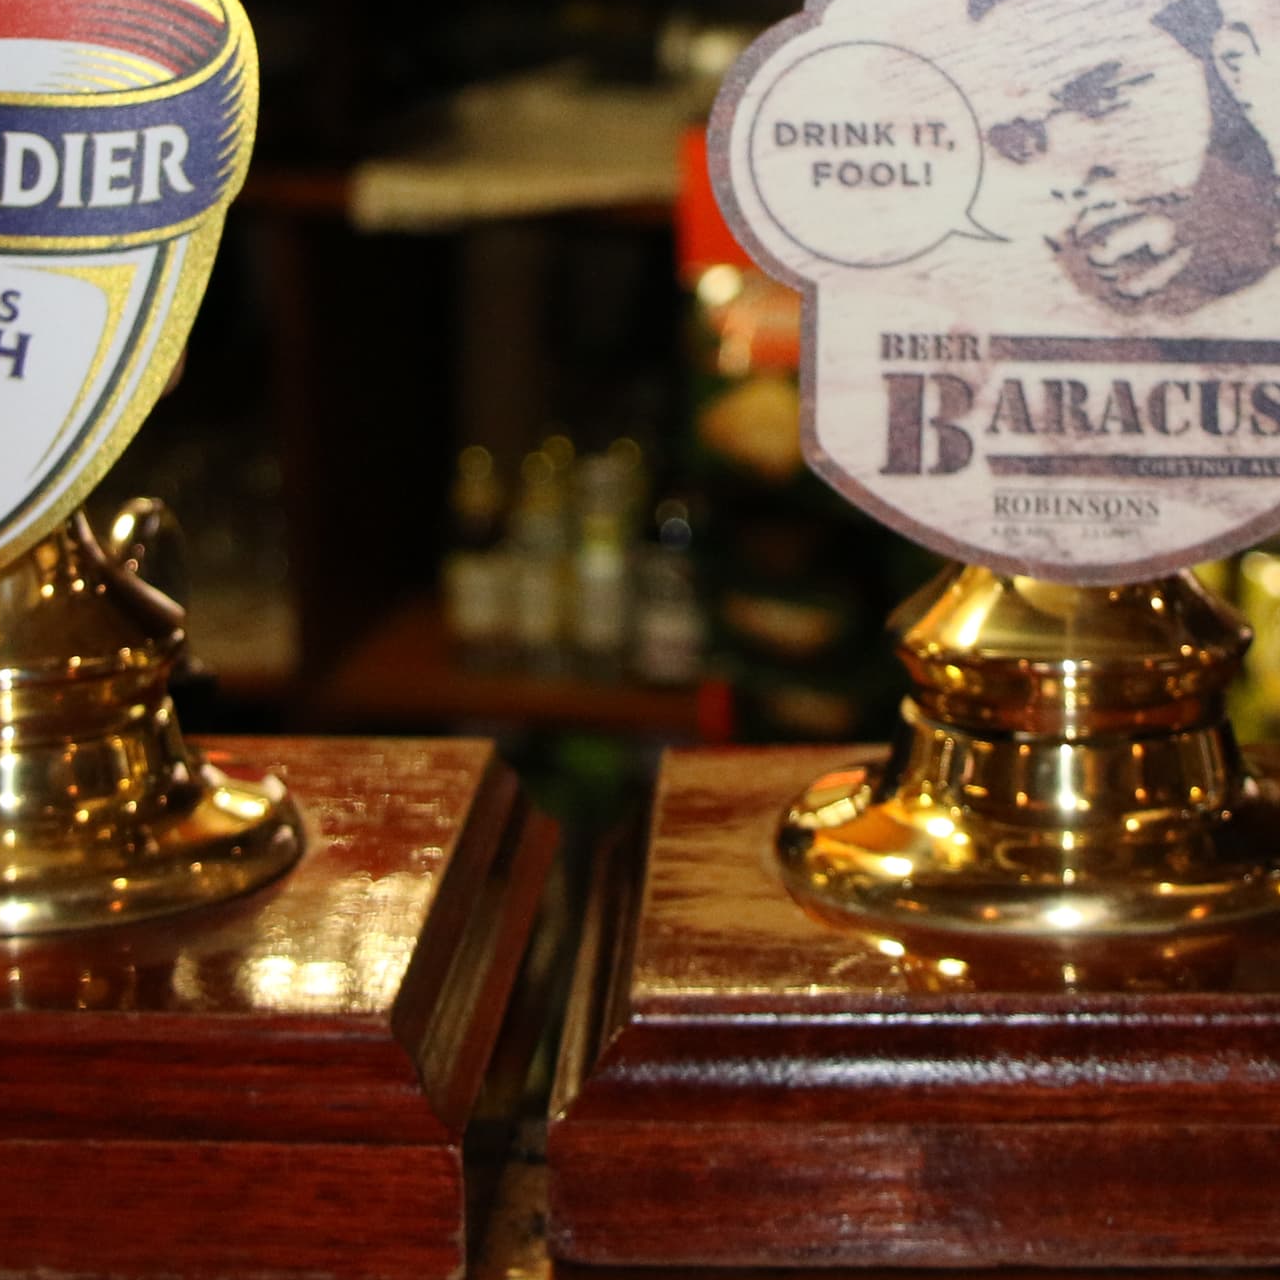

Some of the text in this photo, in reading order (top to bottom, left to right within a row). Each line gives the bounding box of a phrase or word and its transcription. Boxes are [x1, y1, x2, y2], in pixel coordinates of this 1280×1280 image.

[774, 122, 956, 151] DRINK IT,
[812, 162, 932, 188] FOOL!
[880, 333, 982, 362] BEER
[993, 495, 1161, 521] ROBINSONS
